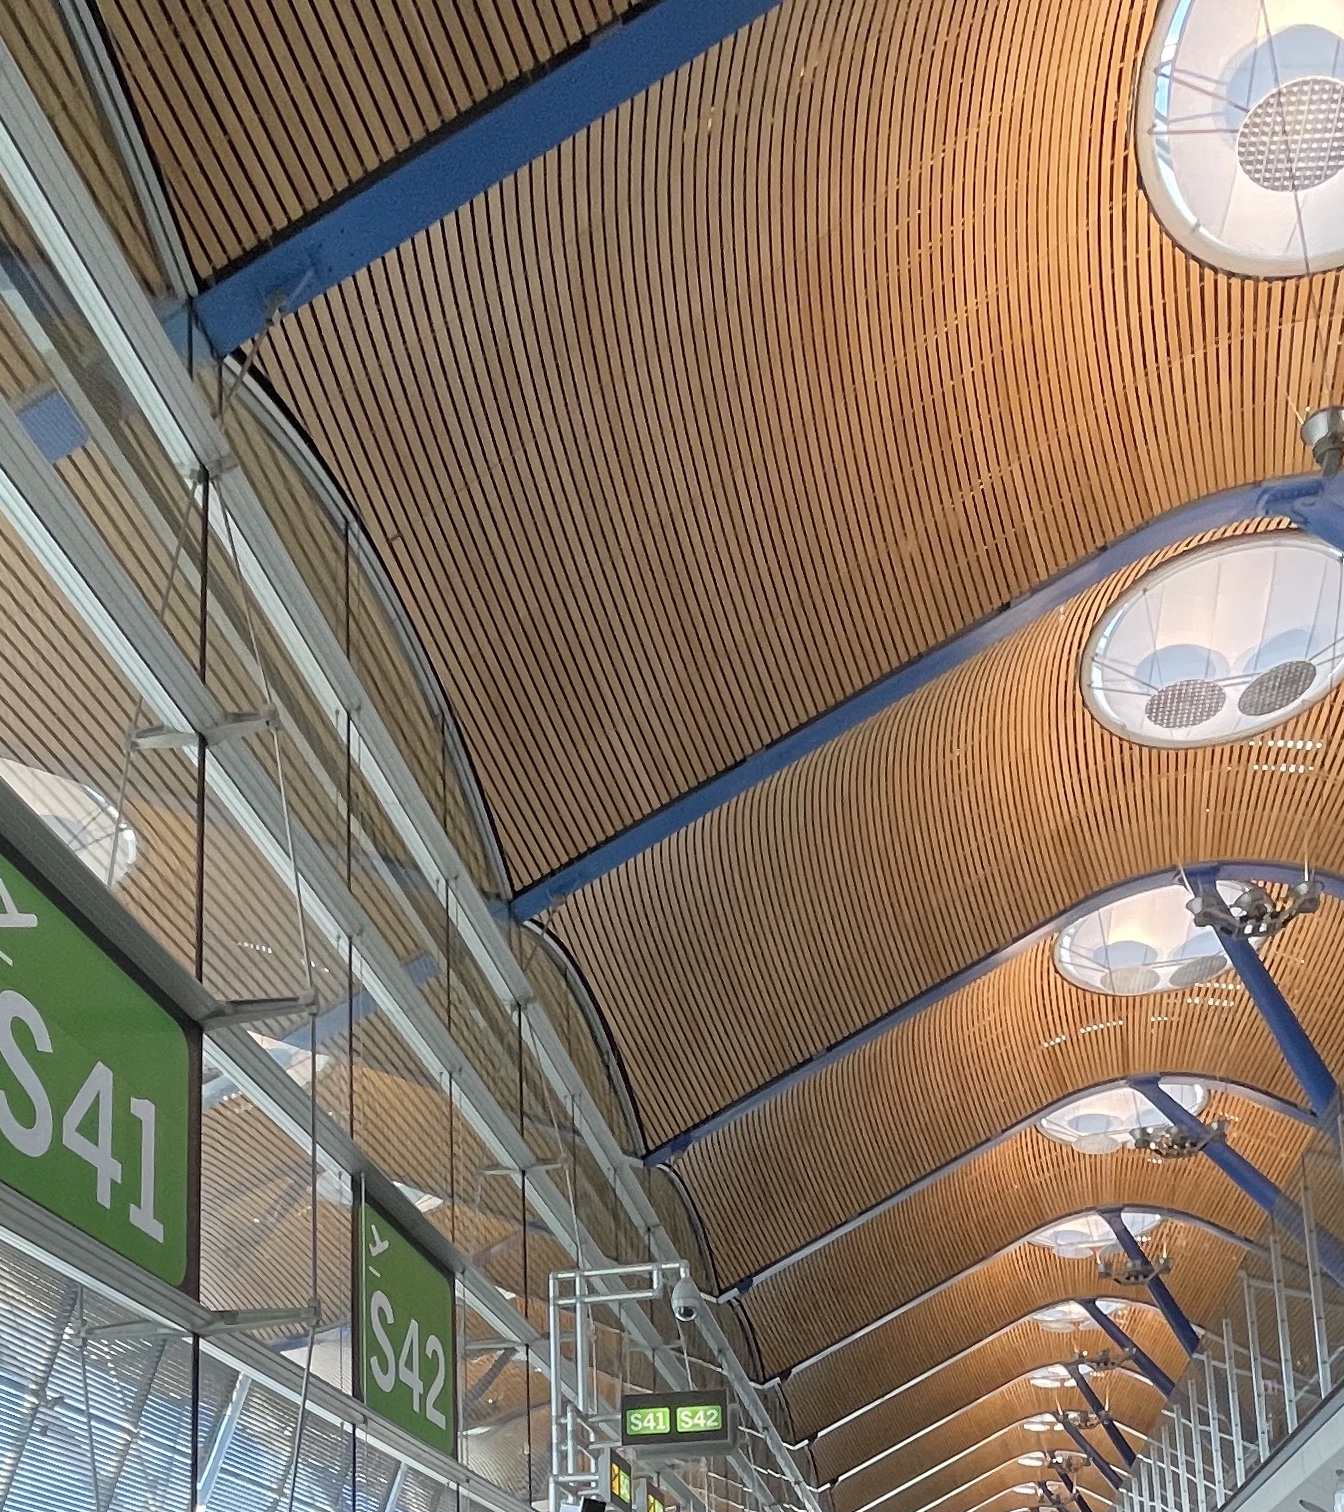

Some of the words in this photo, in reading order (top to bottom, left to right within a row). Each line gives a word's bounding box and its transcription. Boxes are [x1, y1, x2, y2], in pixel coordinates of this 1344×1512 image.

[369, 1290, 447, 1430] S42
[630, 1411, 666, 1431] S41
[680, 1408, 719, 1429] S42
